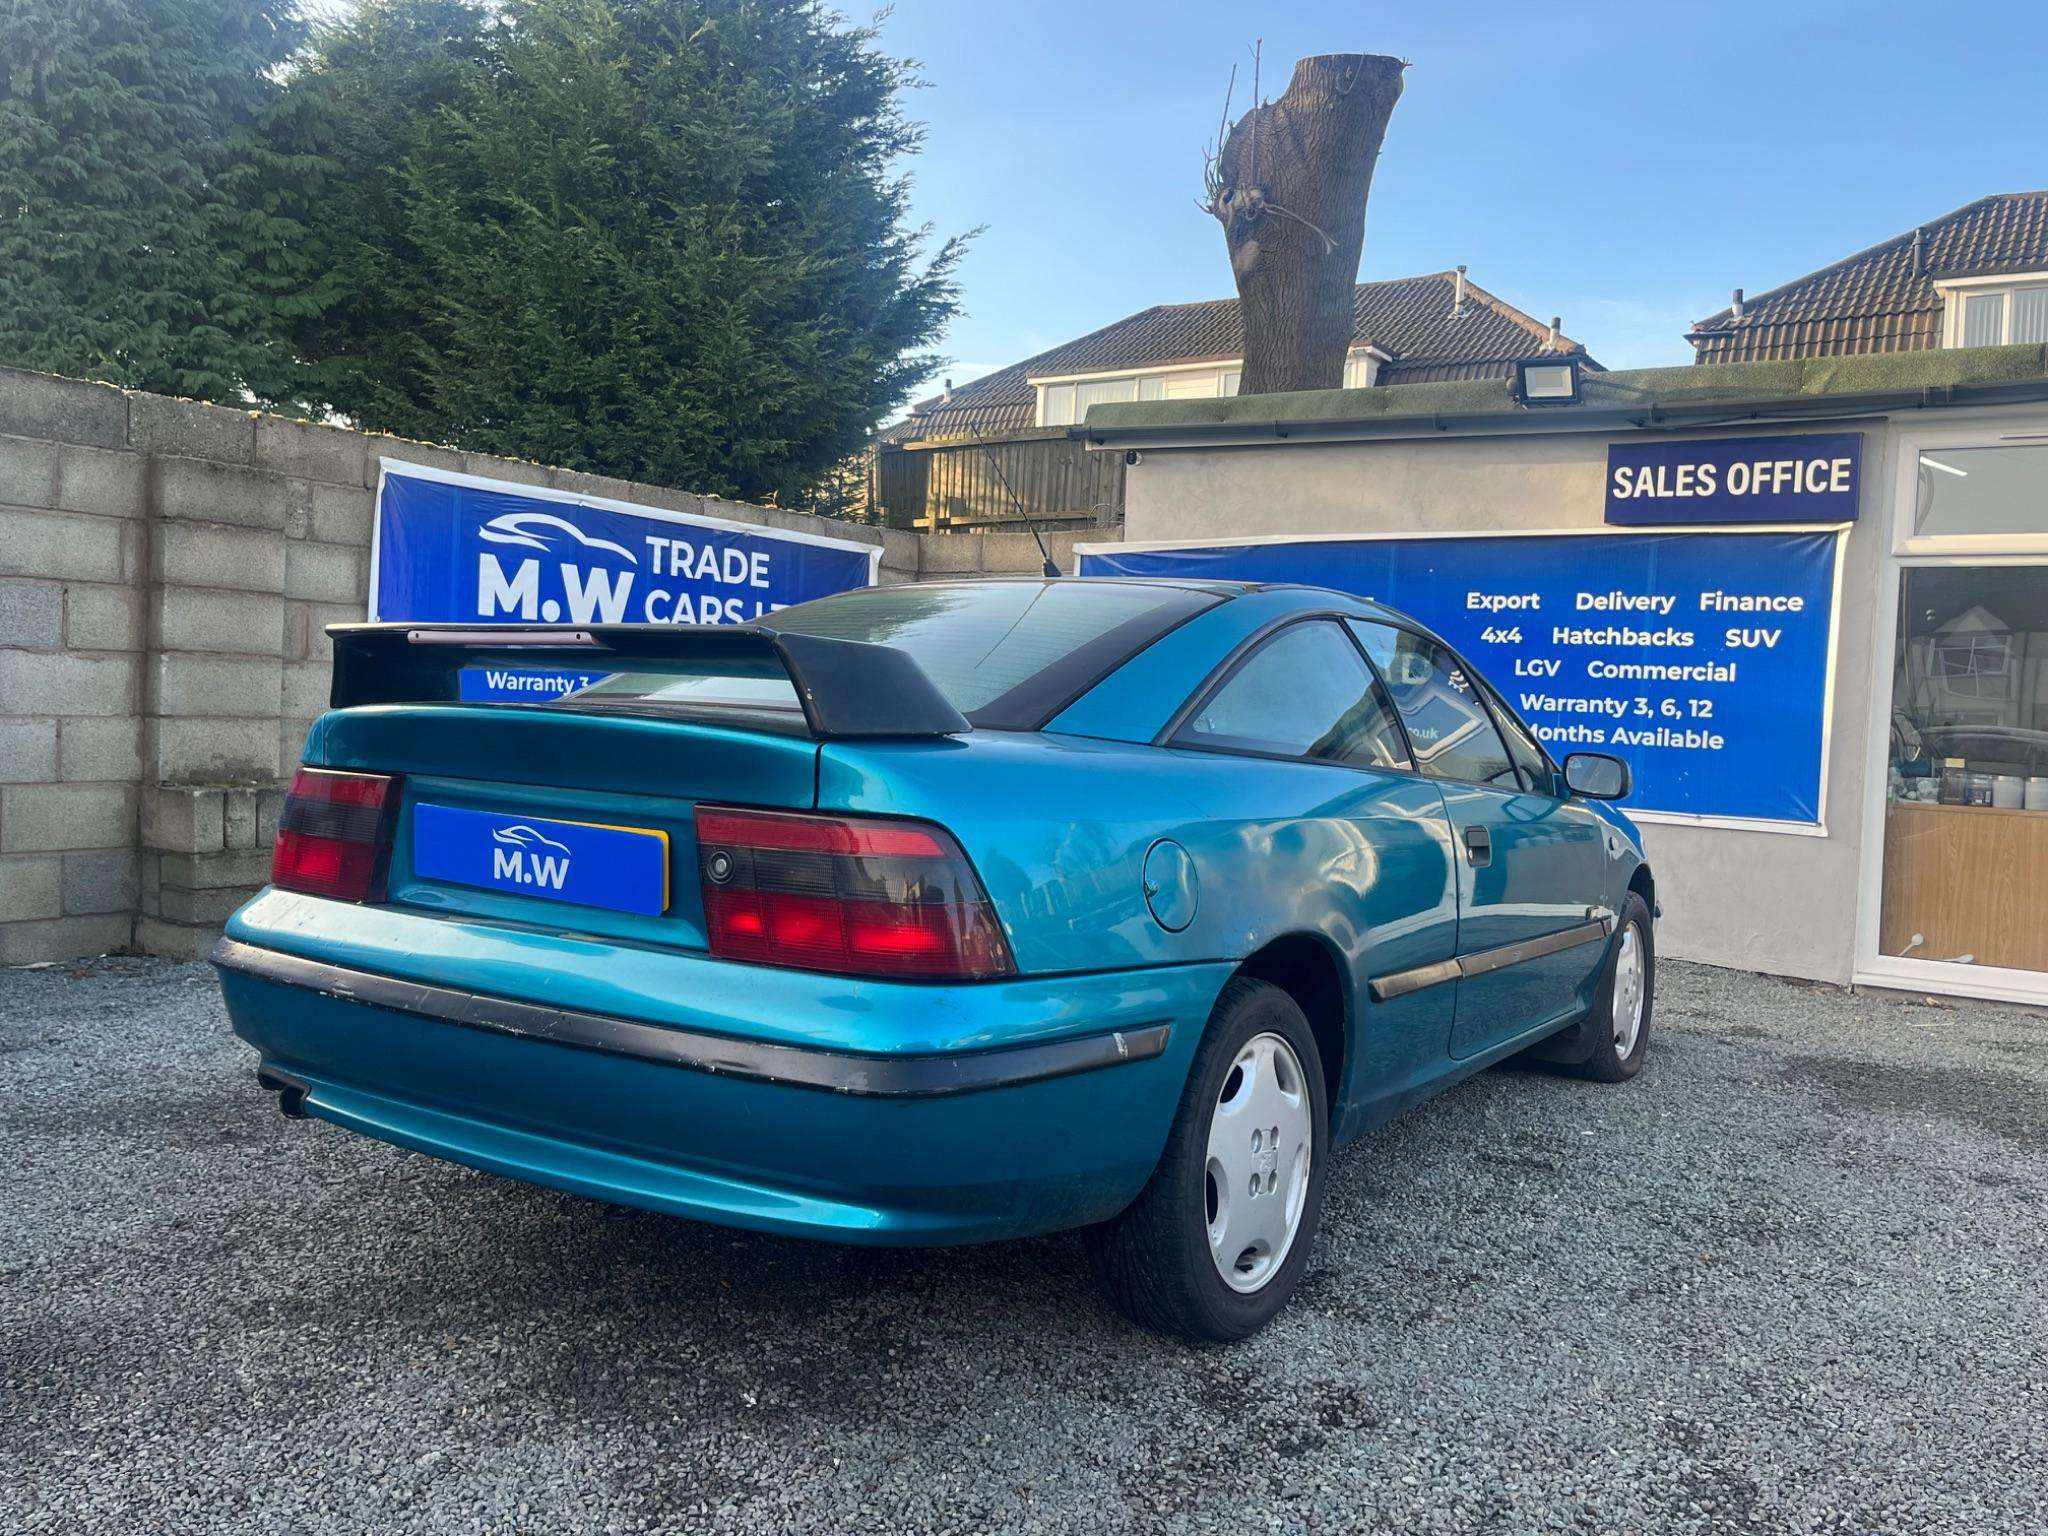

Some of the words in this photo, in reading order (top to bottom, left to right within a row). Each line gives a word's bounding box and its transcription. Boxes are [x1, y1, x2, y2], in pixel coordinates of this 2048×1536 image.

[1612, 463, 1717, 499] SALES
[1727, 457, 1852, 495] OFFICE
[645, 535, 770, 589] TRADE
[477, 552, 635, 624] M.W
[644, 589, 744, 624] CARS
[1466, 592, 1541, 613] Export
[1575, 591, 1676, 615] Delivery
[1700, 591, 1804, 612] Finance
[1480, 626, 1523, 645] 4x4
[1552, 626, 1695, 647] Hatchbacks
[1725, 628, 1782, 648] SUV
[486, 670, 575, 696] Warranty
[1515, 659, 1562, 678] LGV
[1587, 660, 1737, 682] Commercial
[1519, 693, 1629, 718] Warranty
[1633, 697, 1654, 719] 3,
[1660, 698, 1682, 720] 6,
[1688, 699, 1713, 718] 12
[1610, 726, 1724, 750] Available
[493, 847, 570, 890] M.W
